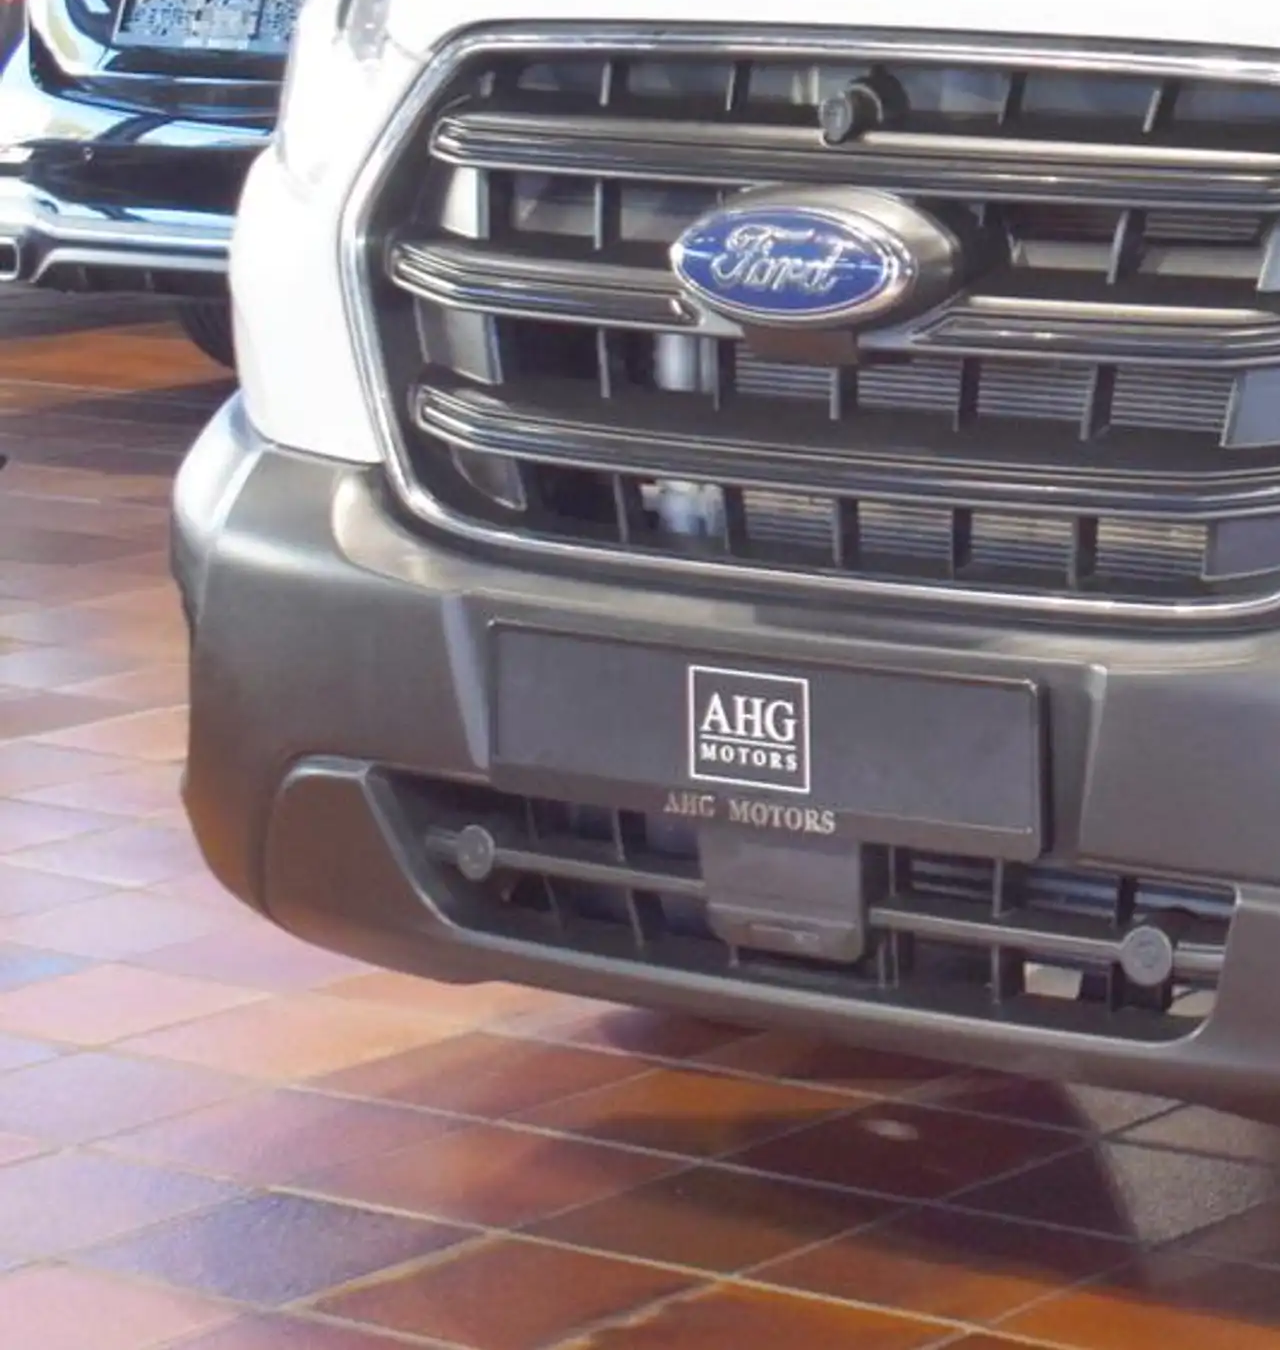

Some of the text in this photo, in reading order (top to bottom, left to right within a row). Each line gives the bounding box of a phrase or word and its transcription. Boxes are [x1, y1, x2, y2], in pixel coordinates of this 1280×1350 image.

[711, 223, 850, 295] Ford
[701, 691, 798, 742] AHG
[701, 743, 798, 772] MOTORS
[729, 799, 836, 835] MOTORS
